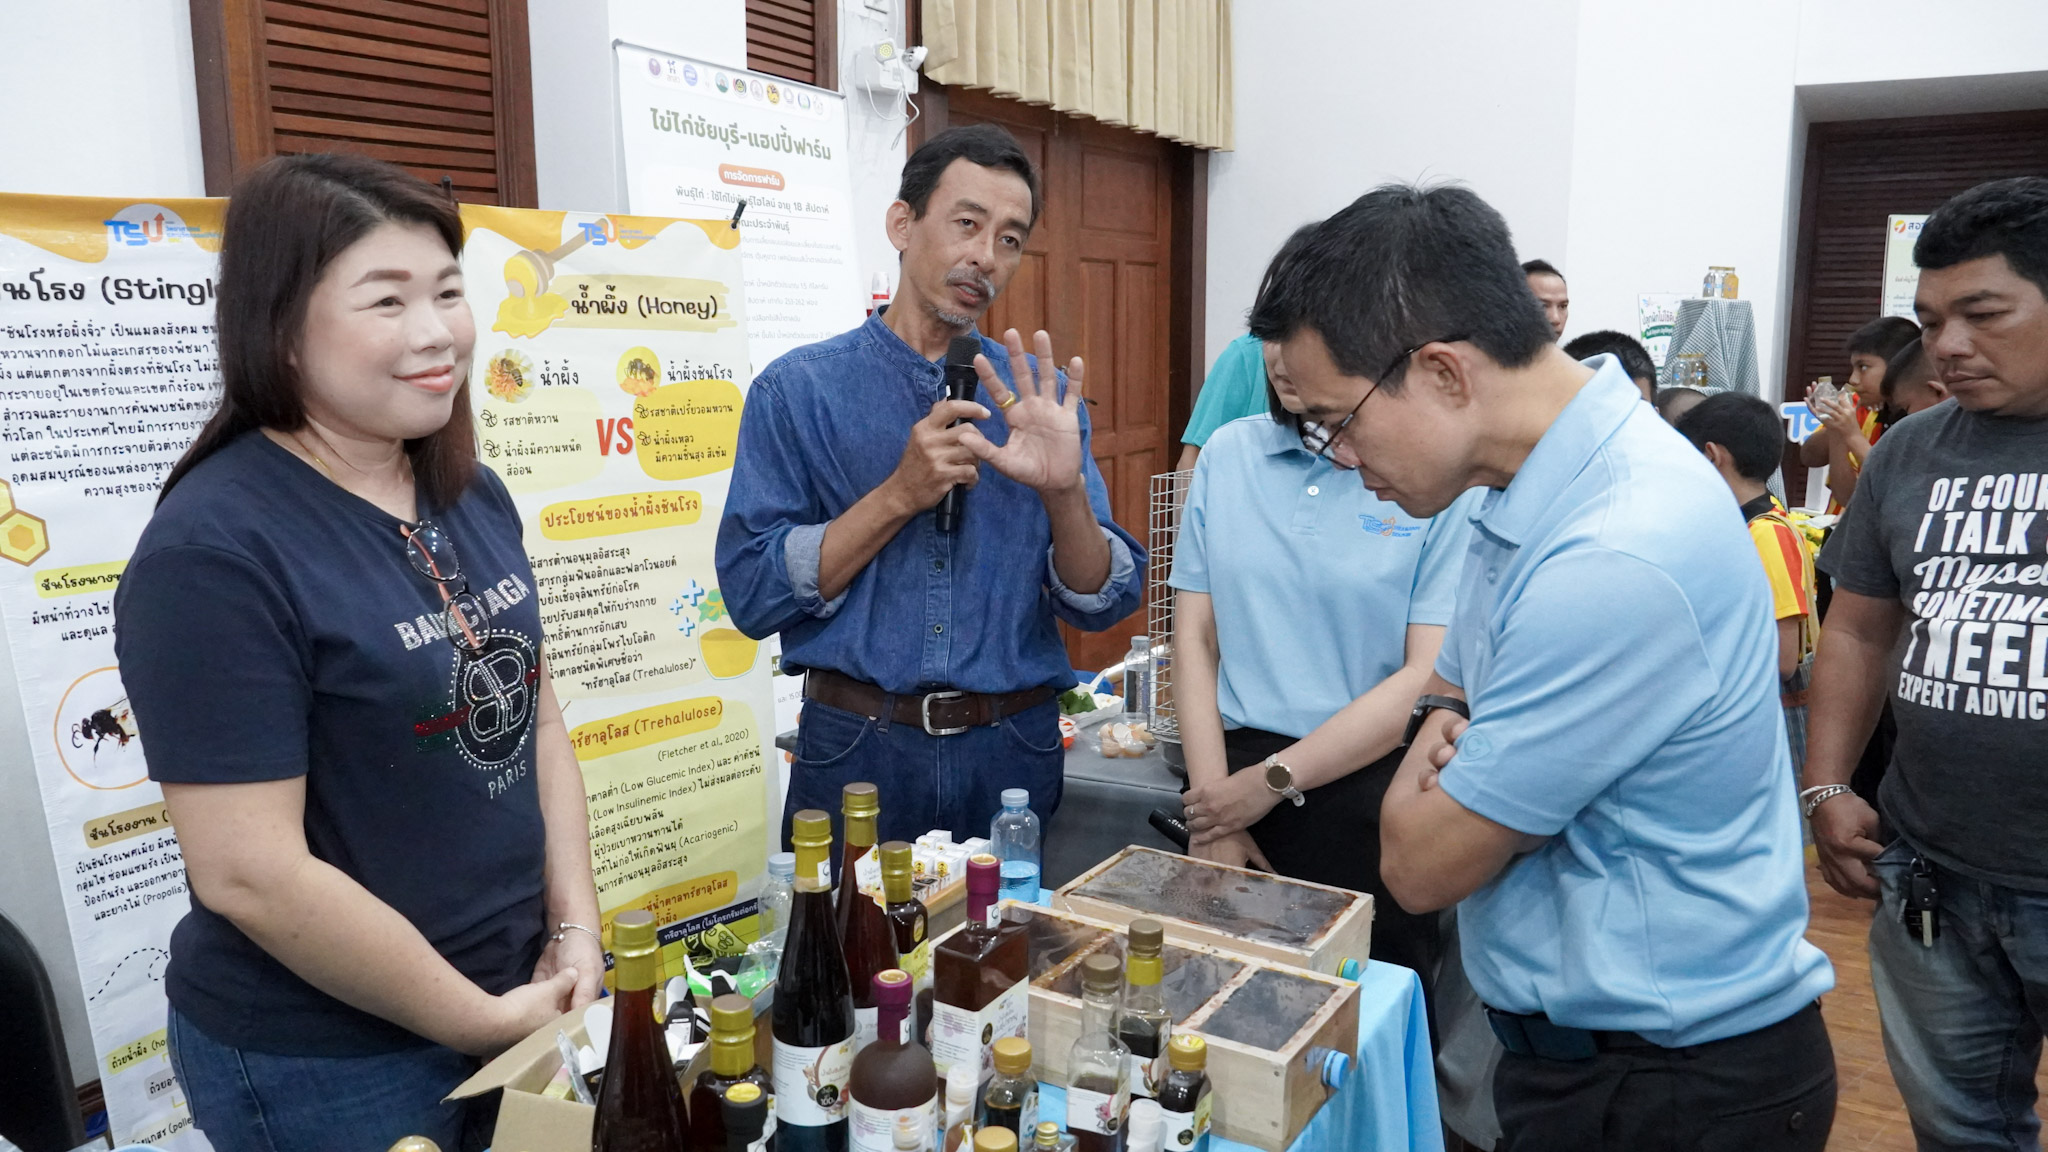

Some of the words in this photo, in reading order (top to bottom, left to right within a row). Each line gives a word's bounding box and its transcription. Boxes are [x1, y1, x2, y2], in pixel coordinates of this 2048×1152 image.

[793, 202, 803, 211] 18
[103, 212, 165, 246] TSU
[578, 215, 618, 246] TSU
[0, 267, 86, 302] นโรง
[101, 275, 216, 306] (Stingl
[571, 284, 628, 315] น้ำผึ้ง
[638, 294, 718, 320] (Honey)
[540, 359, 579, 387] น้ำผึ้ง
[667, 360, 733, 382] น้ำผึ้งชันโรง
[503, 413, 559, 427] รสชาติหวาน
[596, 417, 634, 456] VS
[11, 437, 194, 463] แต่ละชนิดมีการกระจายตัวต่างกั
[84, 472, 166, 498] ความสูงของพื้
[1927, 477, 1970, 512] OF
[545, 494, 699, 528] ประโยชน์ของน้ำผึ้งชันโรง
[1914, 512, 1934, 553] I
[1940, 510, 2038, 555] TALK
[540, 581, 640, 606] บยั้งเชื้อจุลินทรีย์ก่อโรค
[541, 597, 657, 625] วยปรับสมดุลให้กับร่างกาย
[1902, 618, 1926, 670] I
[1897, 671, 1960, 712] EXPERT
[634, 700, 724, 736] (Trehalulose)
[657, 743, 698, 762] (Fletcher
[700, 741, 709, 750] et
[725, 728, 750, 745] 2020)
[487, 759, 528, 800] PARIS
[620, 782, 644, 796] (Low
[646, 769, 686, 787] Glucemic
[688, 759, 716, 777] Index)
[593, 808, 614, 823] (Low
[616, 793, 667, 812] Insulinemic
[669, 781, 697, 799] Index)
[679, 820, 739, 849] (Acariogenic)
[142, 881, 188, 906] (Propolis)
[151, 1039, 166, 1051] (ho
[168, 1117, 193, 1135] (polle
